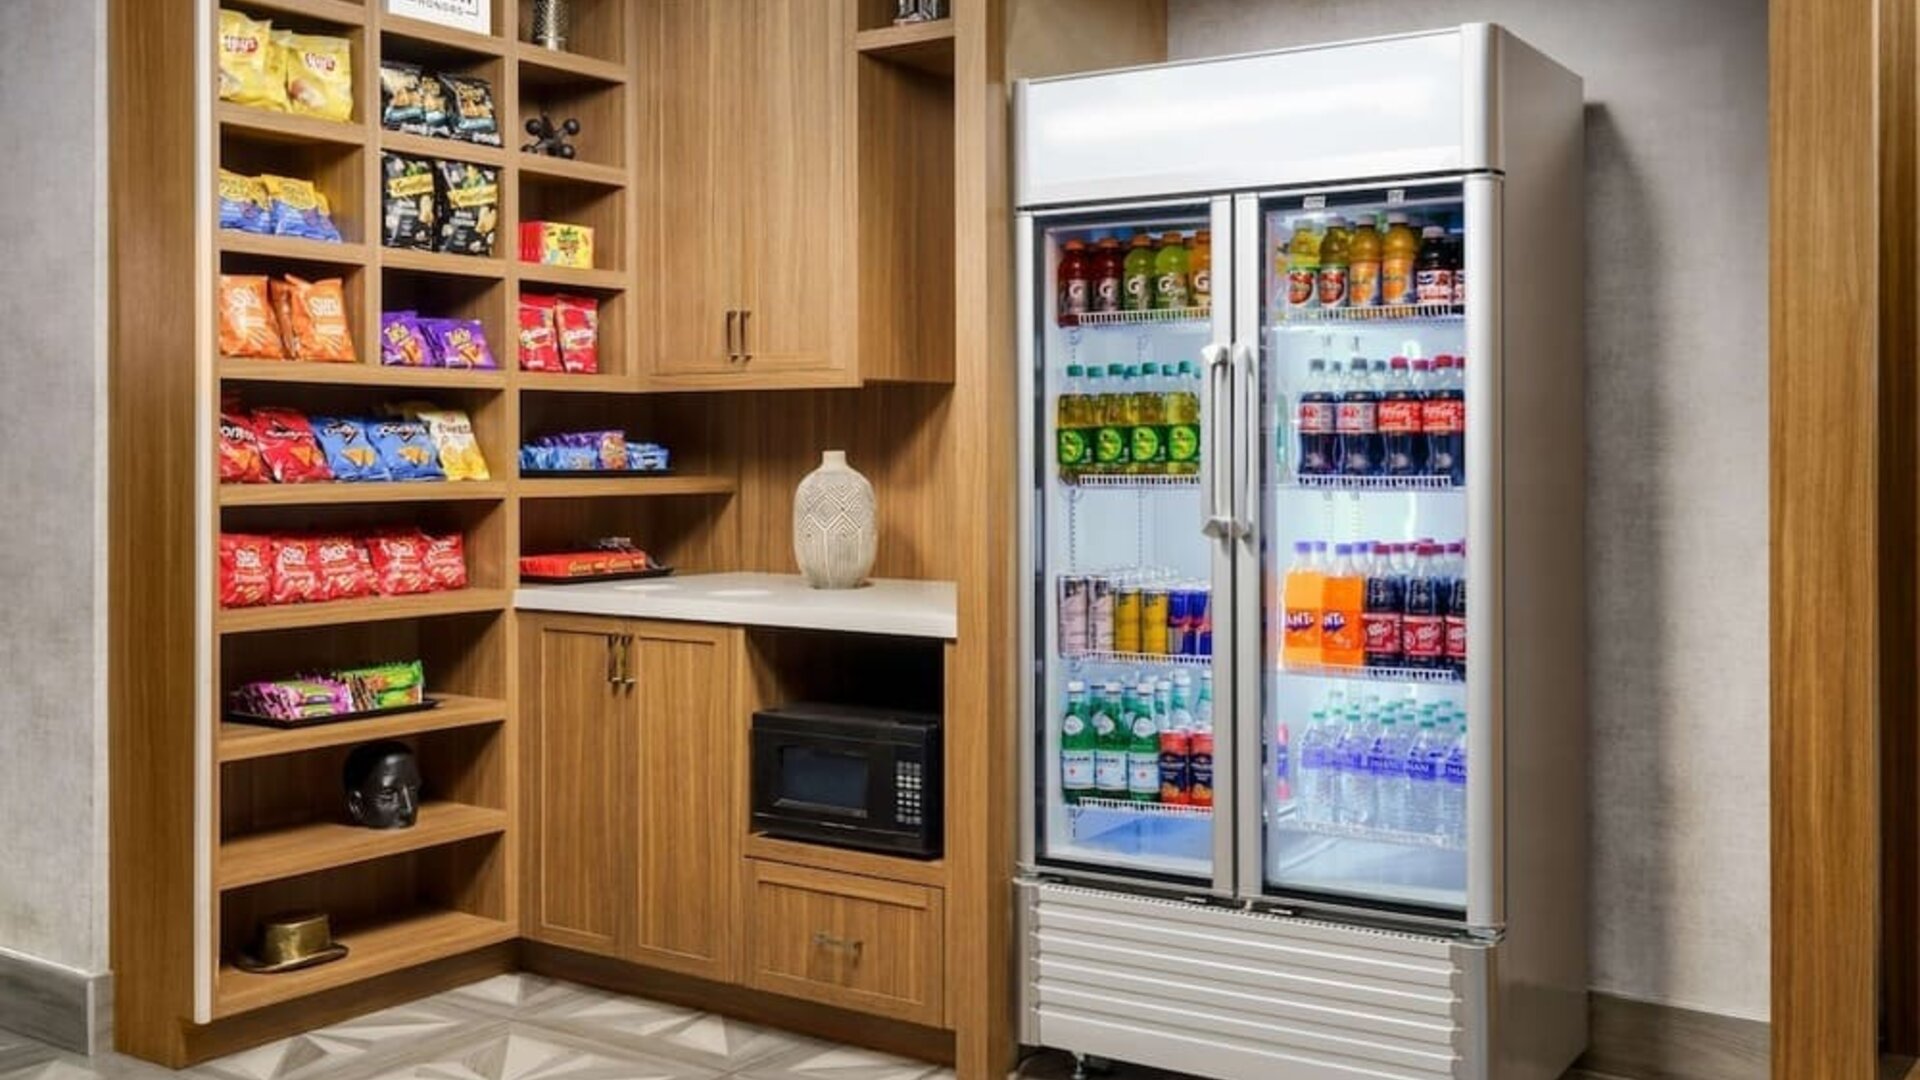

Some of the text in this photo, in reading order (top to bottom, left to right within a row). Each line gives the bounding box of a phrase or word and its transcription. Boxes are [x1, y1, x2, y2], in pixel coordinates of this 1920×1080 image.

[1069, 284, 1083, 298] G
[1099, 282, 1113, 297] G
[1128, 277, 1140, 293] G
[1158, 275, 1172, 292] G
